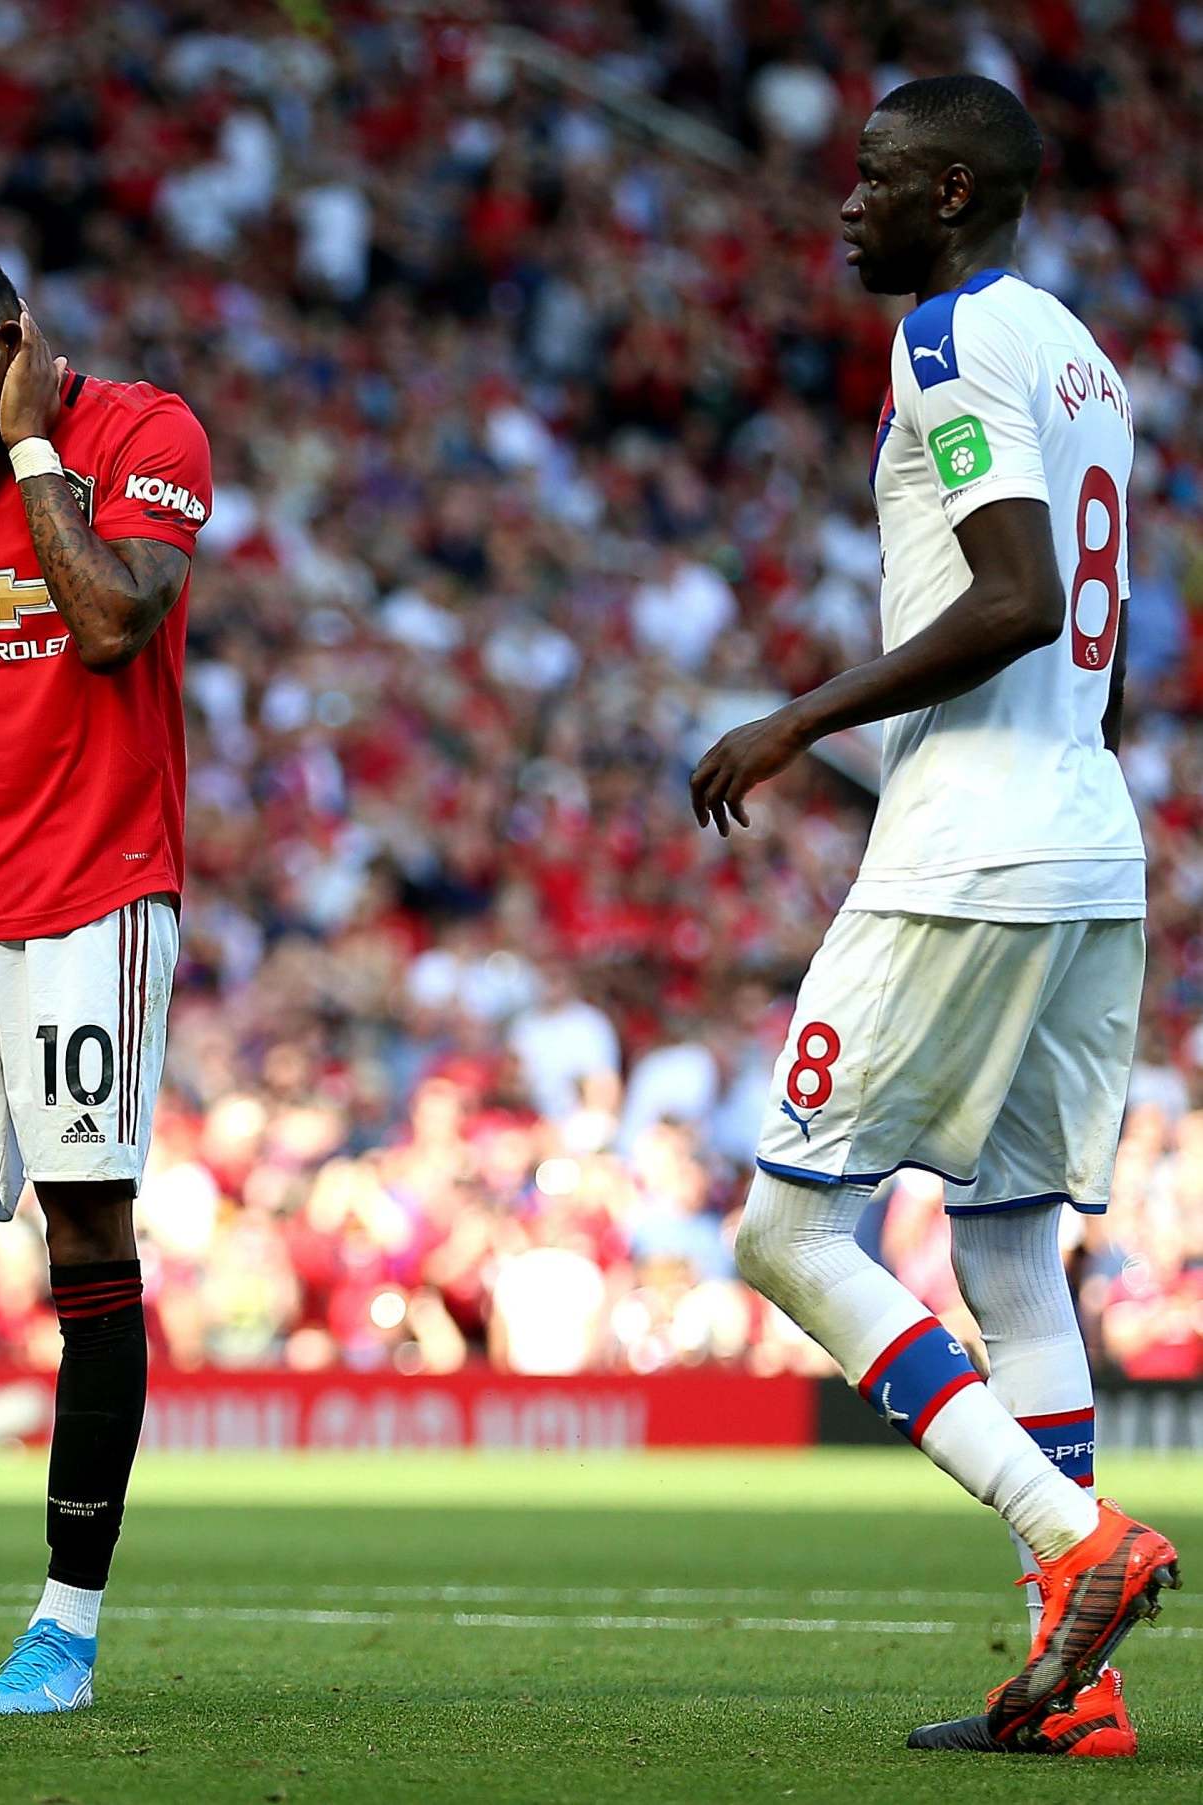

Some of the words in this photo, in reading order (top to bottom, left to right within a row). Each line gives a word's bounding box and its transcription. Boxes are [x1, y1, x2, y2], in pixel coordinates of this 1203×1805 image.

[1071, 465, 1120, 671] 8
[35, 1024, 114, 1106] 10
[787, 1021, 841, 1109] 8
[61, 1130, 106, 1144] adidas
[59, 1506, 95, 1517] UNITED
